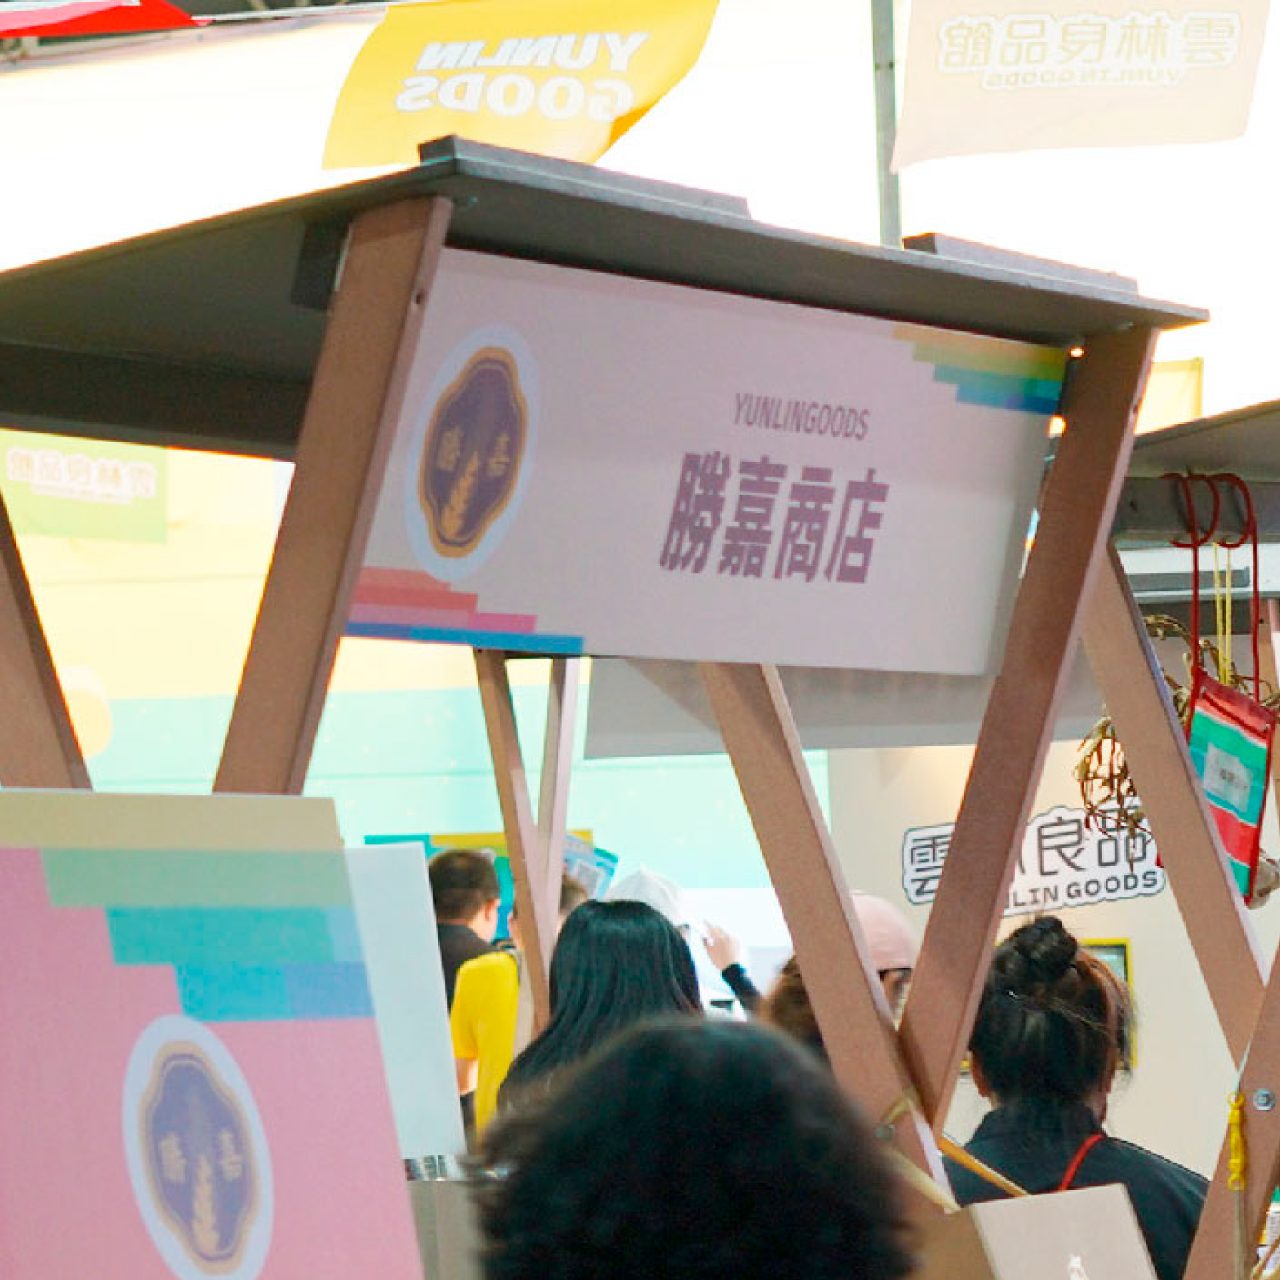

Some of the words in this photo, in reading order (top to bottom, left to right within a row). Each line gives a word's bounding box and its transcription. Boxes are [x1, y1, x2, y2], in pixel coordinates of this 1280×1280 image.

[734, 392, 869, 441] YUNLINGOODS
[660, 451, 890, 584] 勝嘉商店
[910, 806, 1148, 897] 雲良品
[1011, 885, 1058, 907] LIN
[1067, 870, 1159, 899] GOODS
